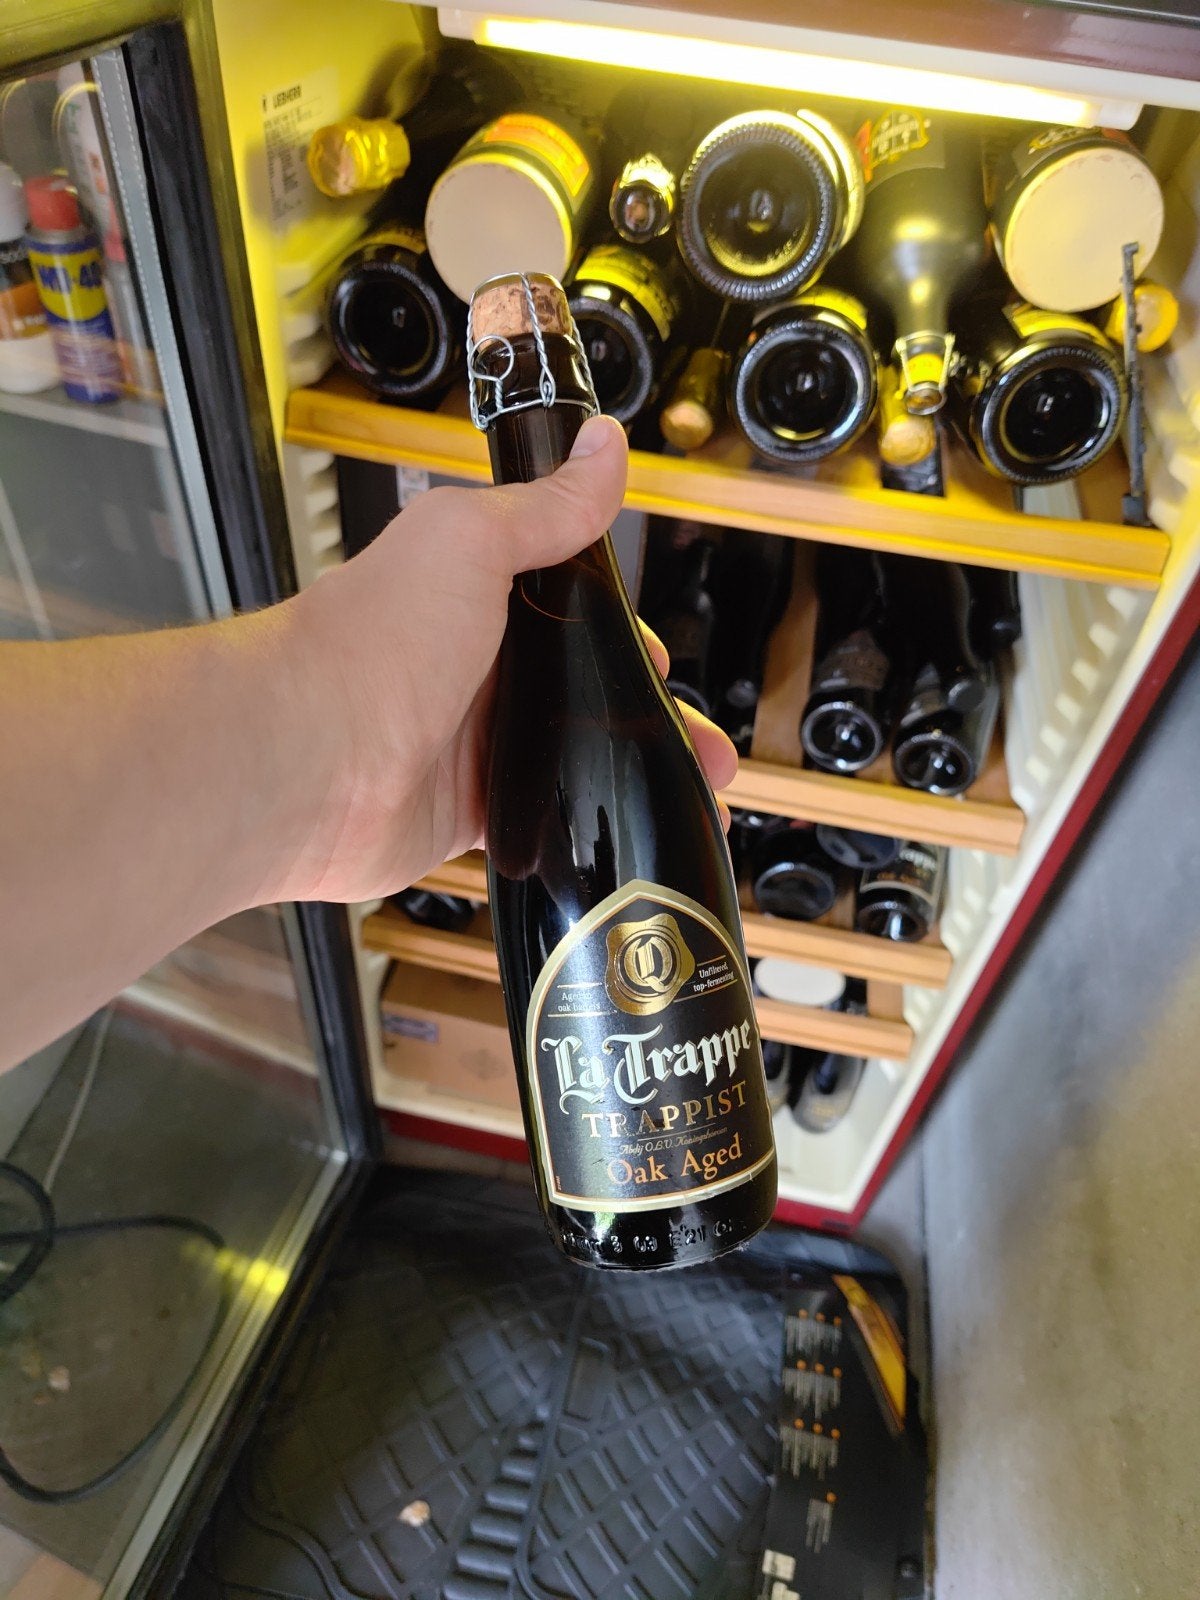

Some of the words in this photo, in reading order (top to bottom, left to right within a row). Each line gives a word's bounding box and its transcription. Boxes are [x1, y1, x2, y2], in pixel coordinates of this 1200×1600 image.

[557, 1002, 571, 1013] oak
[541, 1035, 611, 1115] La
[601, 1023, 751, 1104] Trappe
[581, 1080, 747, 1138] TRAPPIST
[606, 1156, 669, 1185] Oak
[680, 1132, 743, 1181] Aged
